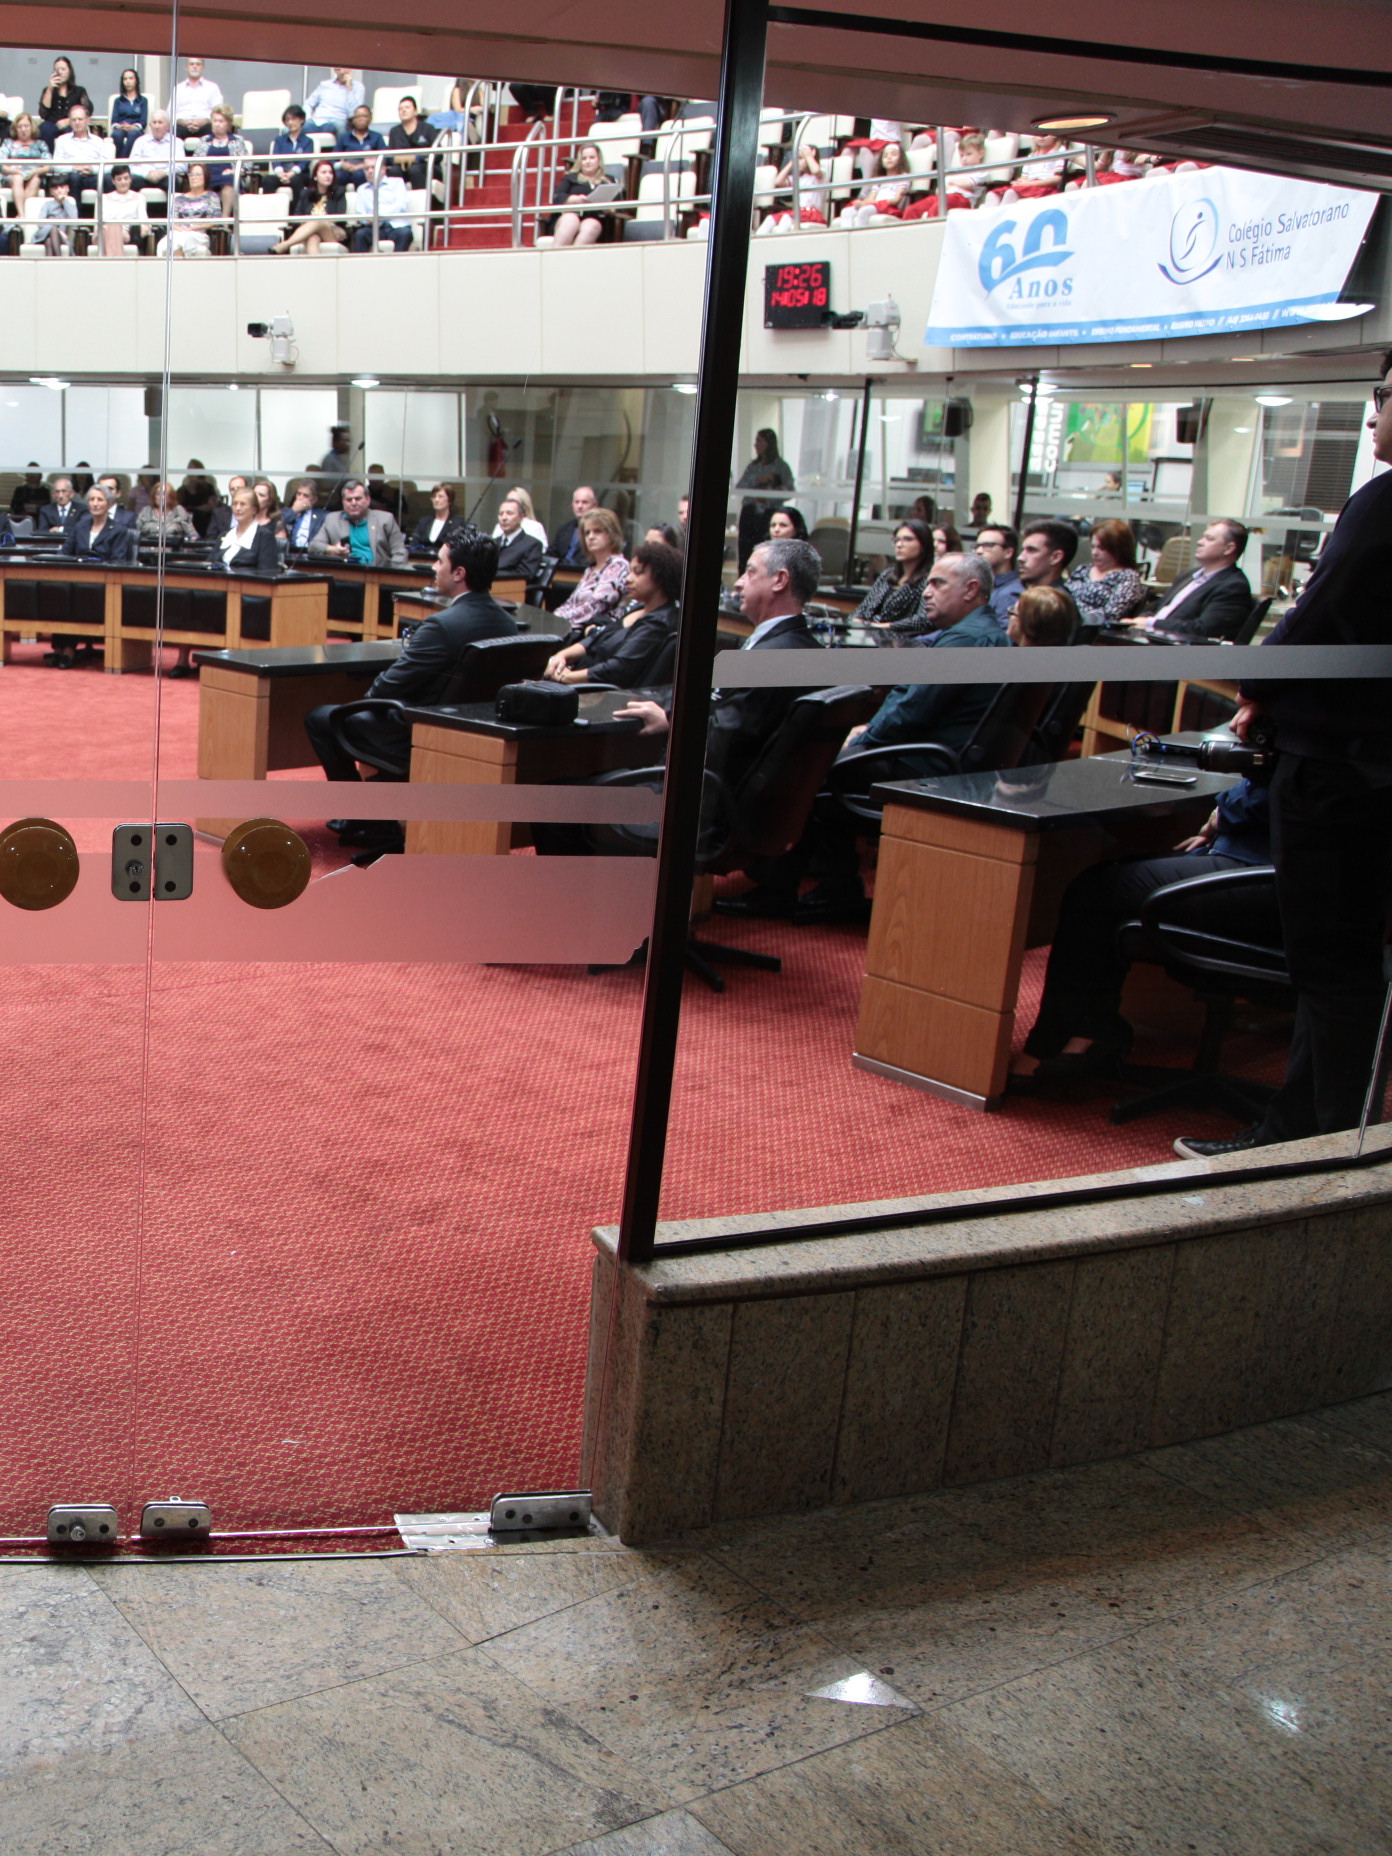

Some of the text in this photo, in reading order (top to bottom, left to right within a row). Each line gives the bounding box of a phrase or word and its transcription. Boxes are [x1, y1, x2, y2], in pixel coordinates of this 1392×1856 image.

[1228, 203, 1349, 244] Colégio Salvatorano
[978, 208, 1068, 293] 60
[1226, 243, 1291, 270] N S Fátima
[776, 263, 823, 289] 19:26
[1008, 276, 1073, 300] Anos
